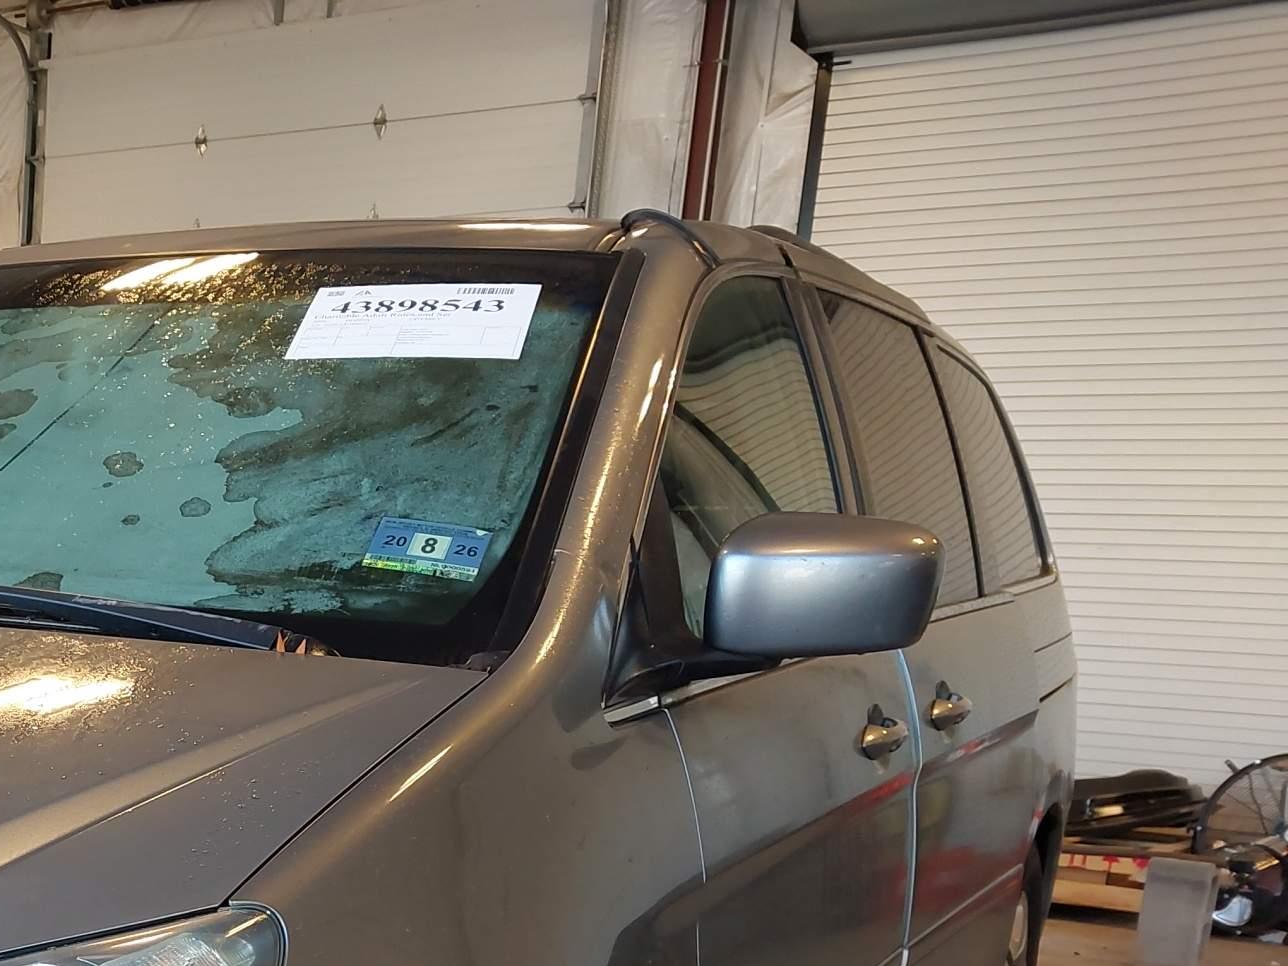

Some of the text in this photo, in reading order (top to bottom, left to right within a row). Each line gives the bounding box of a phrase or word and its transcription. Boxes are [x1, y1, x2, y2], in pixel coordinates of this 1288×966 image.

[331, 299, 505, 314] 43898543
[383, 535, 479, 557] 20 8 26
